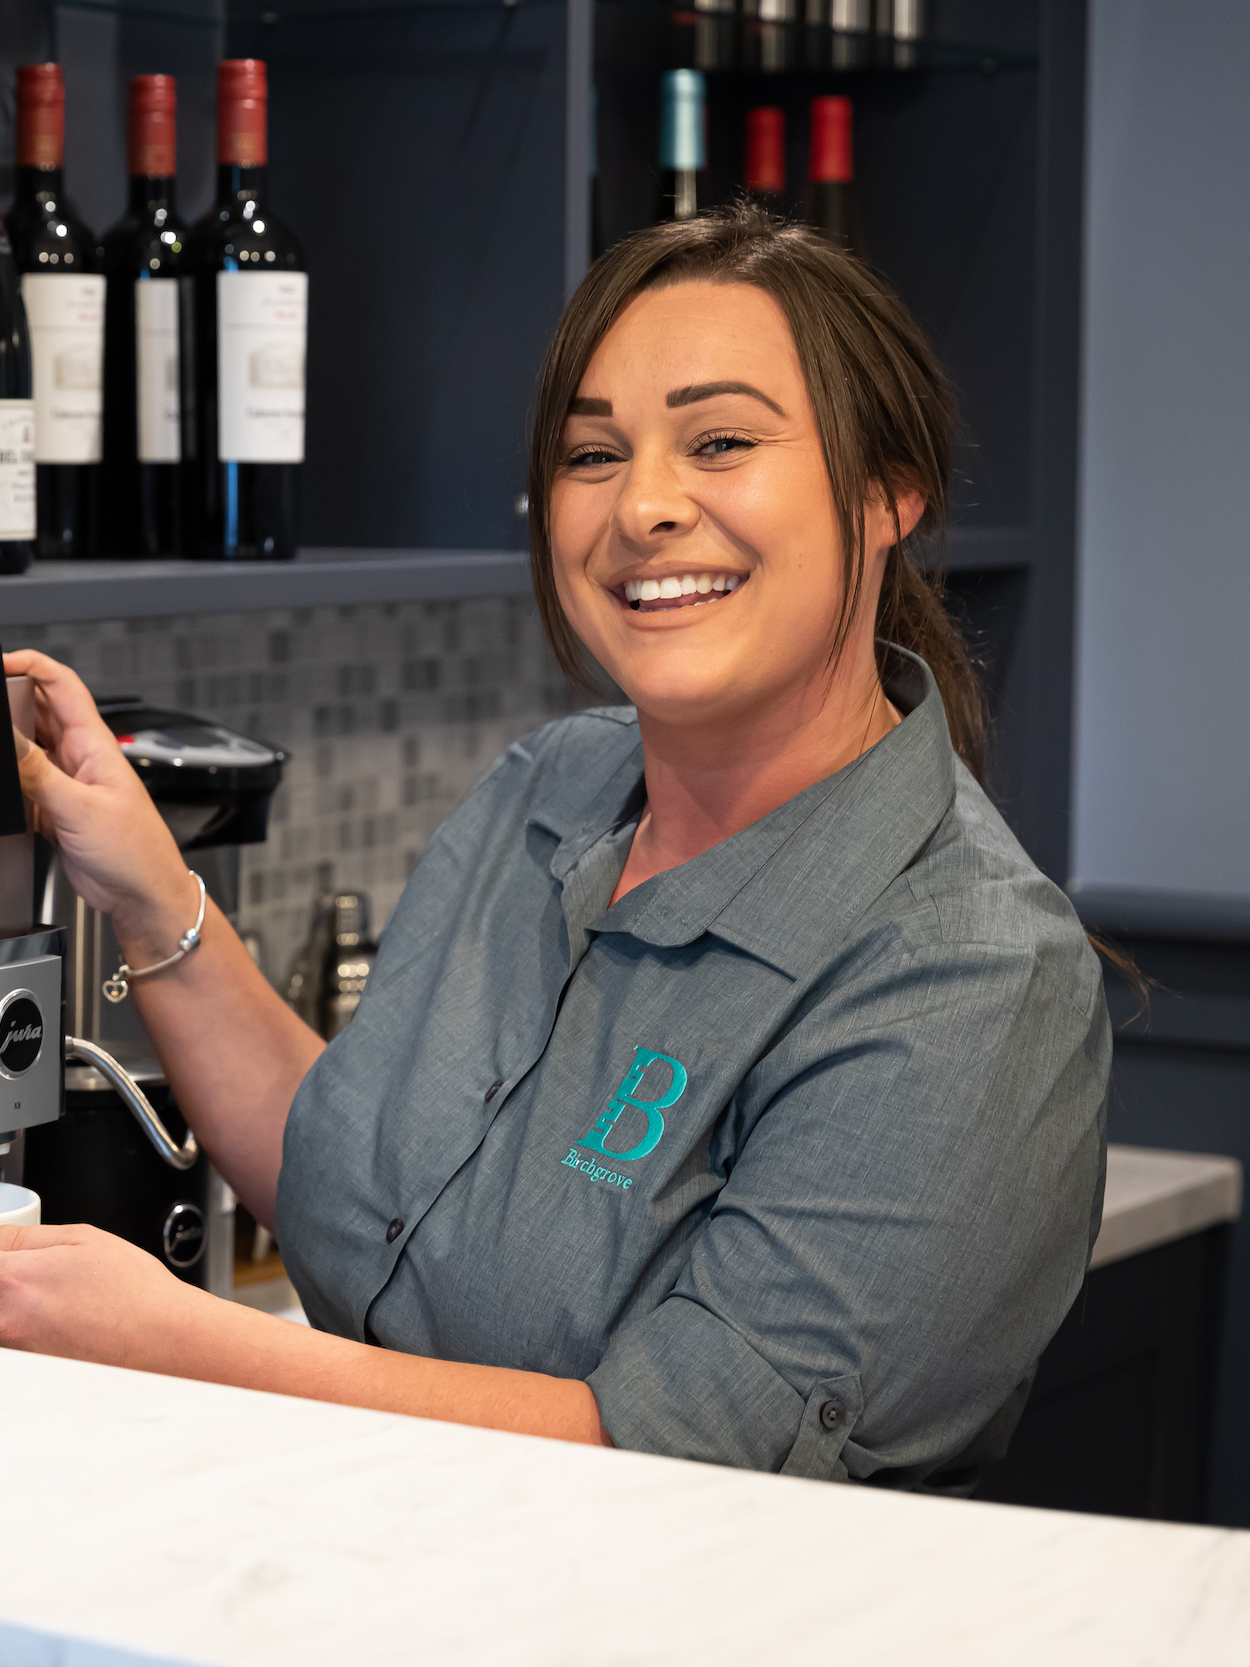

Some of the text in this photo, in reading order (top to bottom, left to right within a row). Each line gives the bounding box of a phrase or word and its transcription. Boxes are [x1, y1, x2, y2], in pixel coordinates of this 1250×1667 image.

[0, 1020, 43, 1054] jura
[574, 1045, 688, 1161] B
[560, 1147, 633, 1190] Birchgrove
